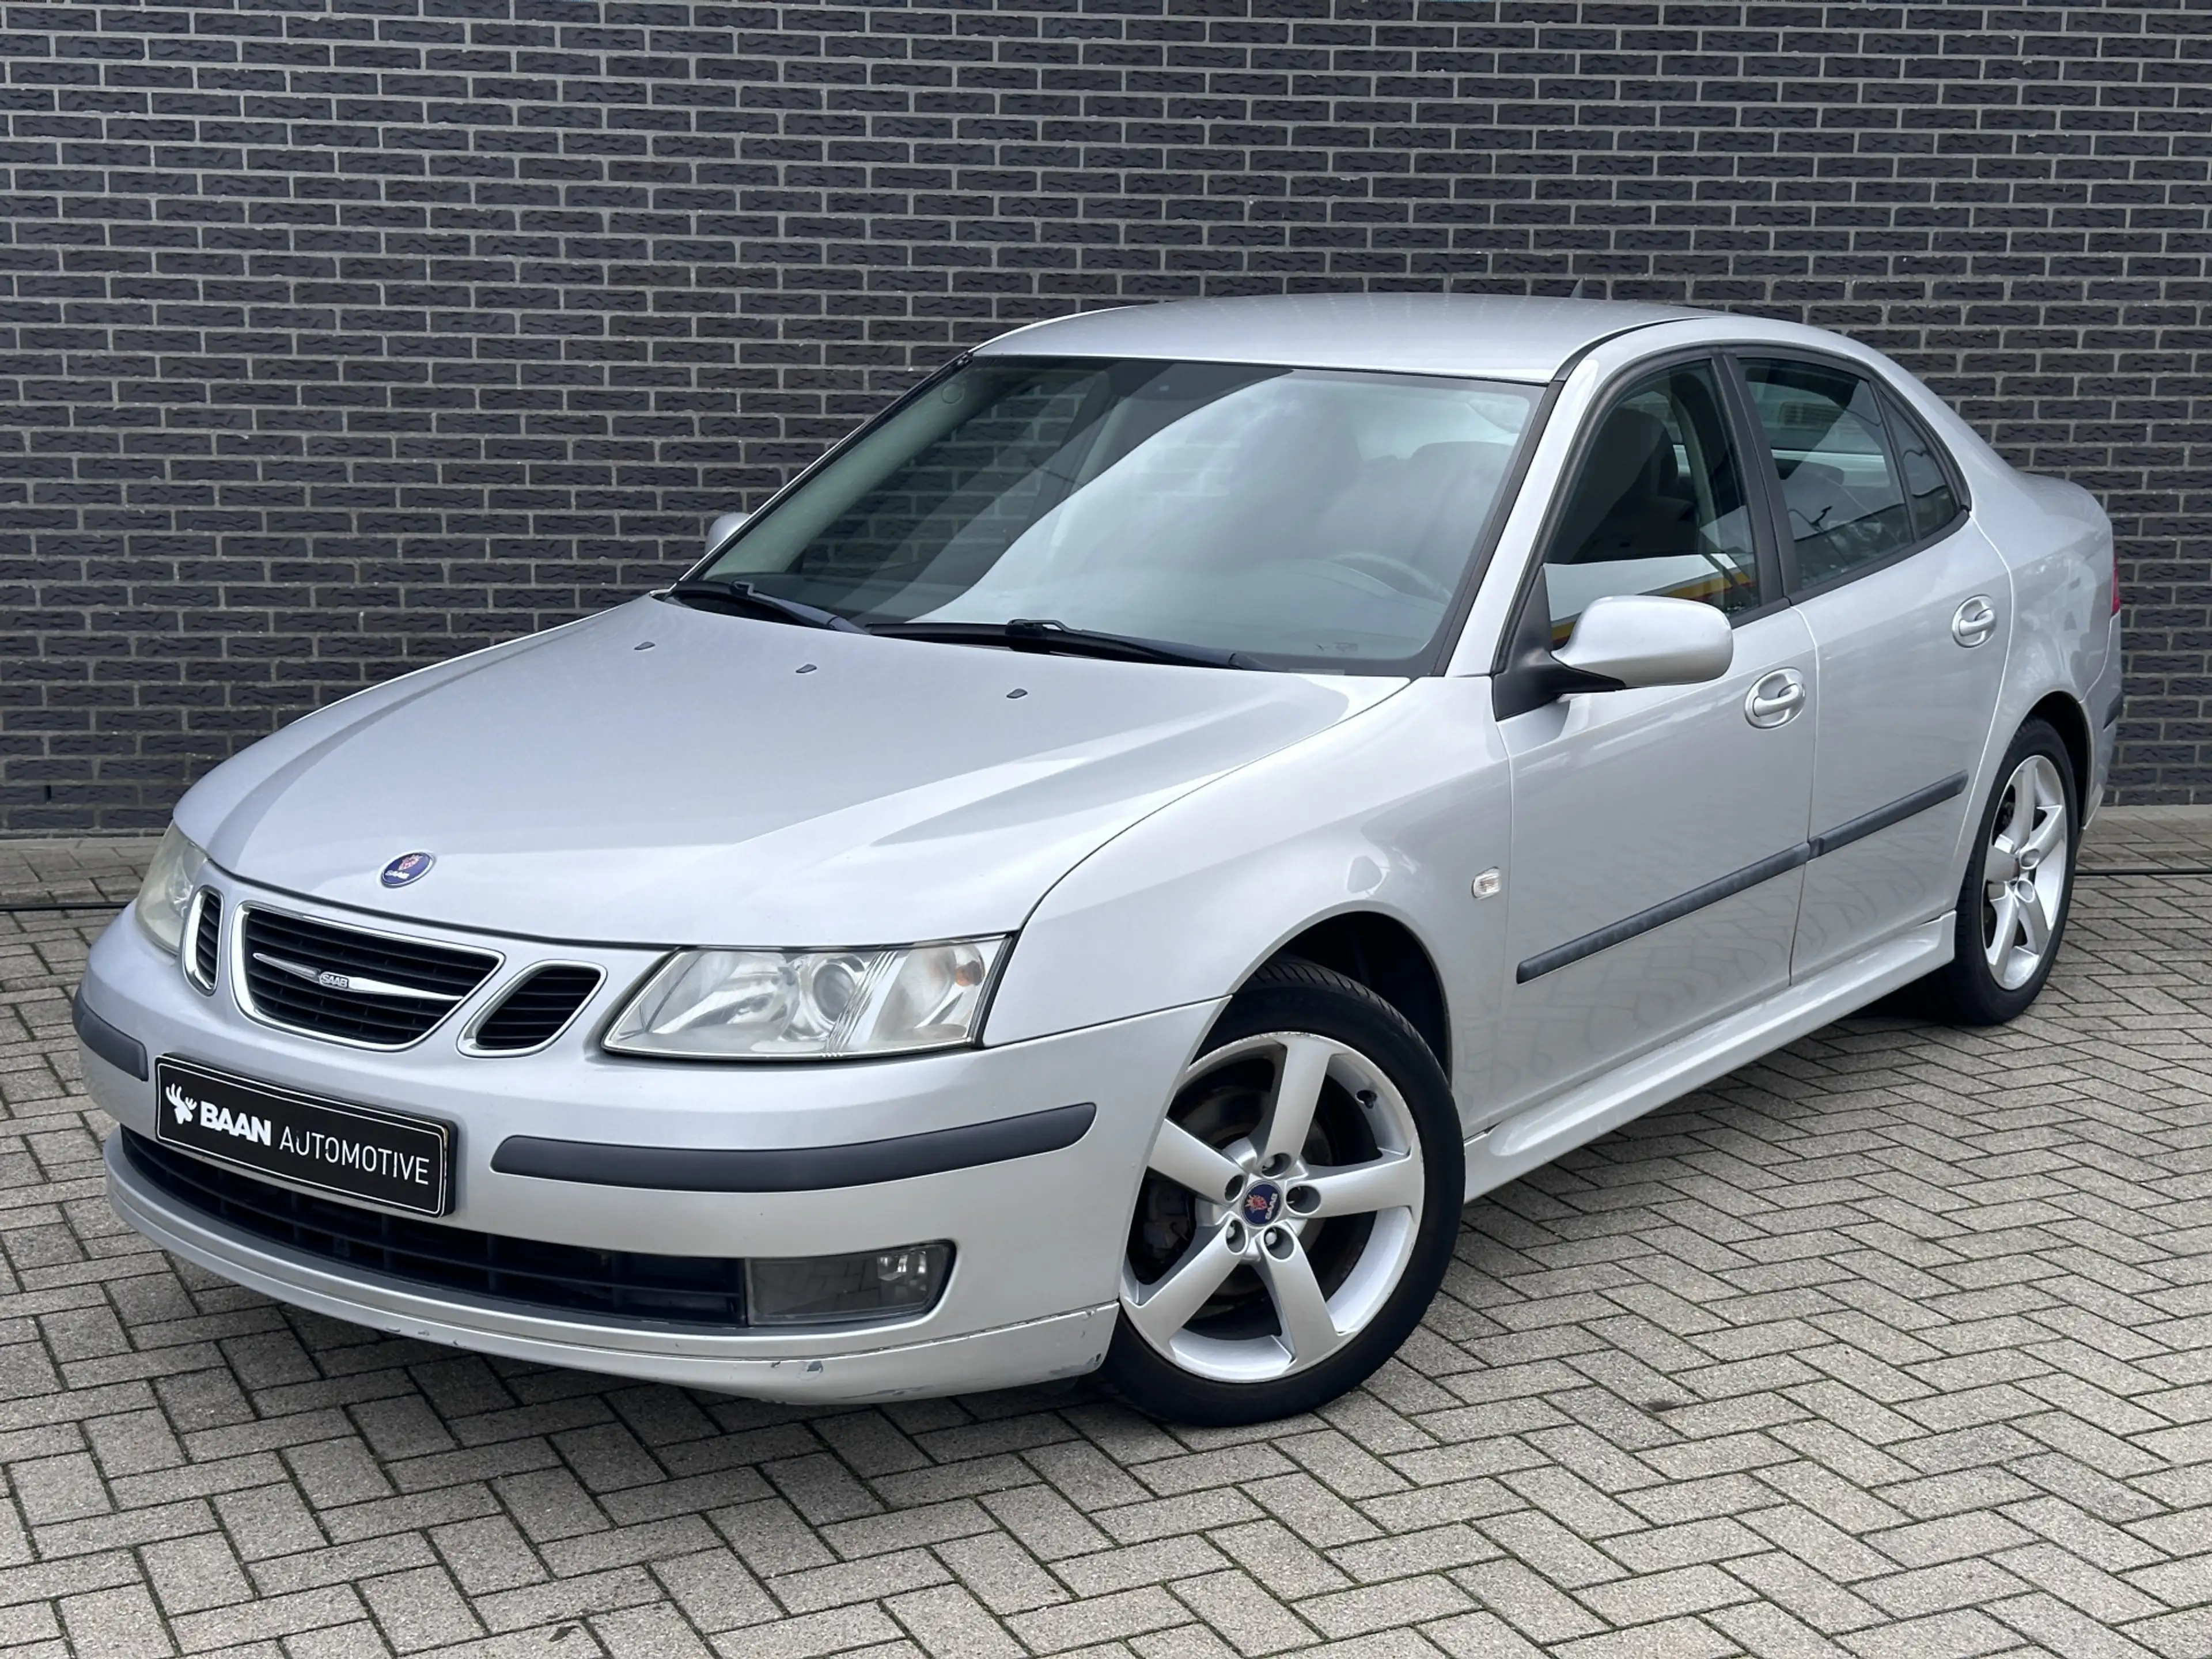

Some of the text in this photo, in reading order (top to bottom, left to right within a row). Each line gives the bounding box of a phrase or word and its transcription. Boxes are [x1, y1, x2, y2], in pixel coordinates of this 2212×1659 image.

[322, 974, 348, 987] SAAB
[200, 1100, 430, 1185] BAAN AUTOMOTIVE
